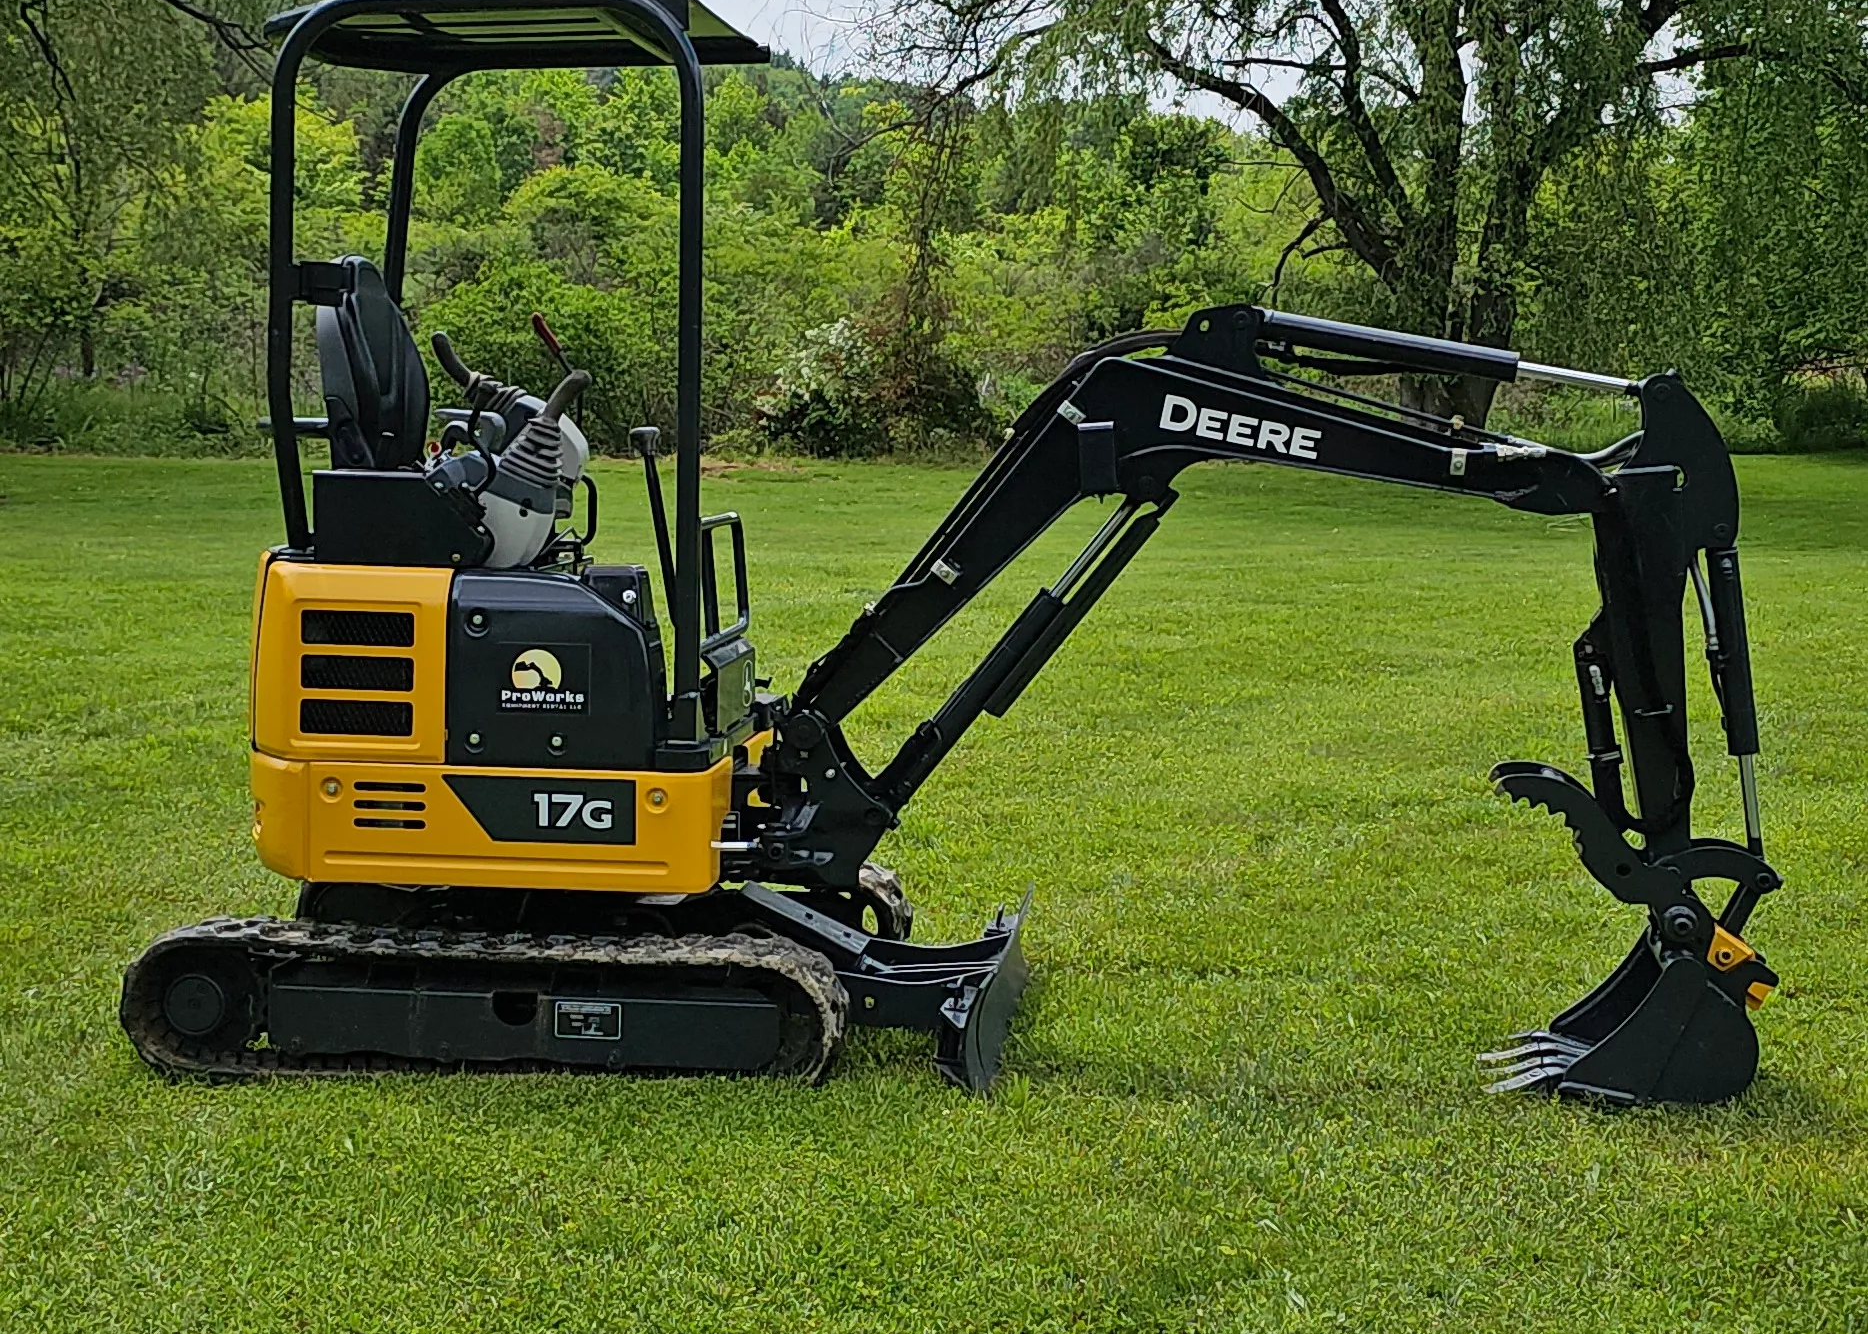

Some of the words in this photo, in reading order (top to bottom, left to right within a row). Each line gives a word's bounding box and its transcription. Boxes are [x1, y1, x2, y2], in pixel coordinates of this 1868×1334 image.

[1159, 394, 1322, 460] DEERE
[501, 689, 585, 703] ProWorks
[533, 793, 612, 829] 17G
